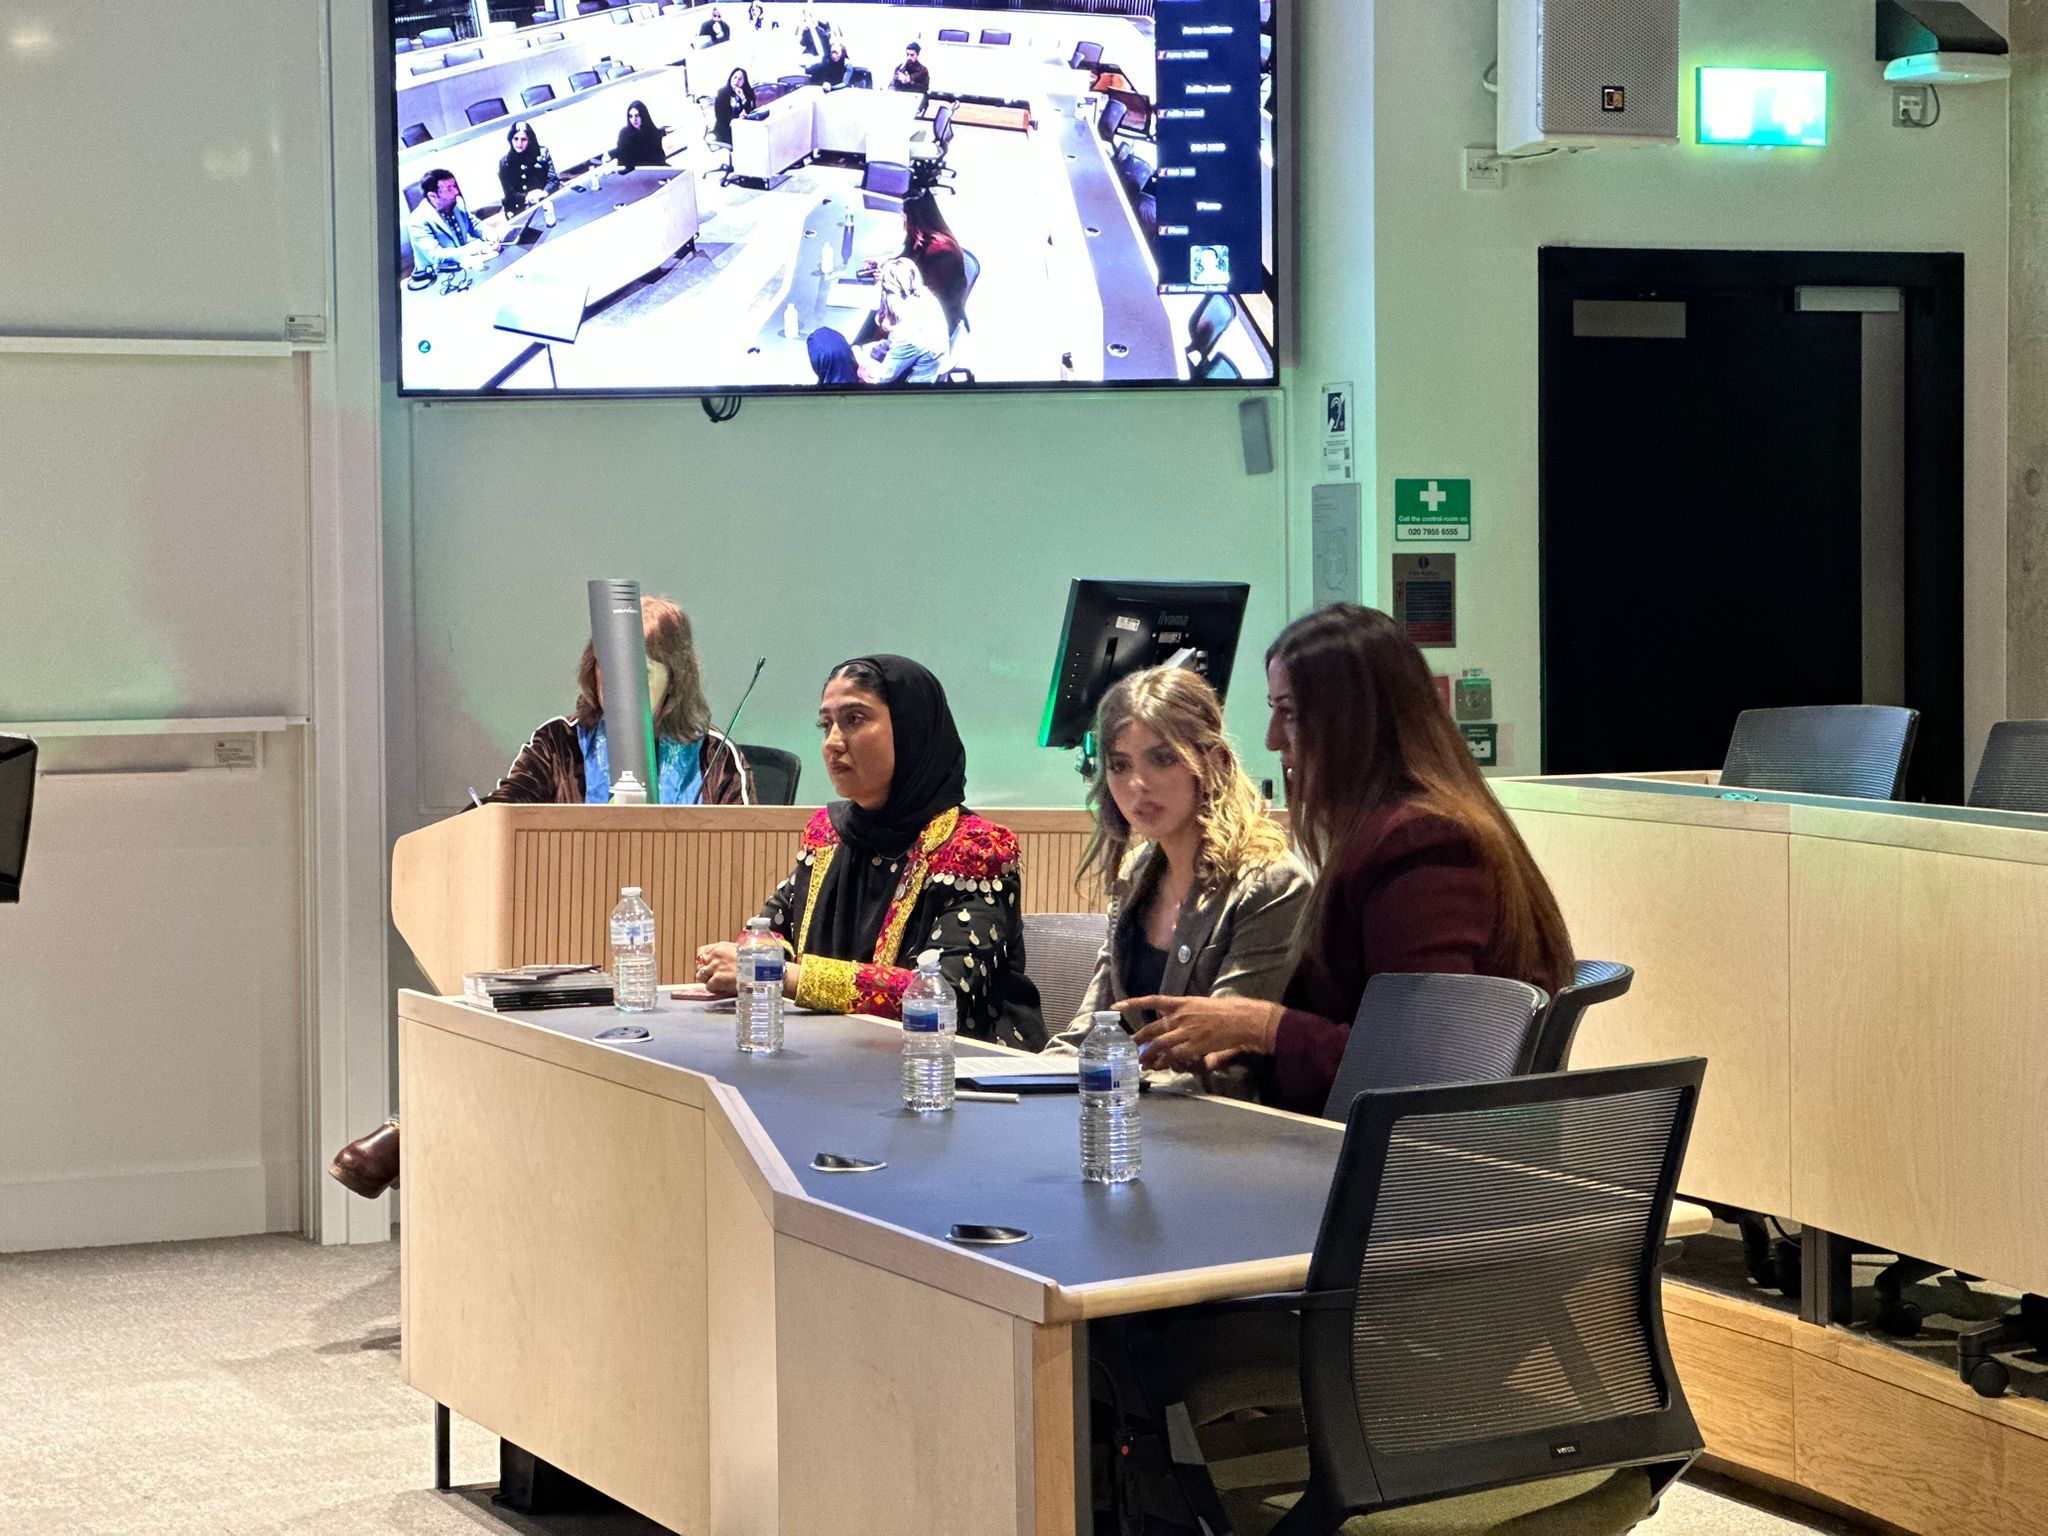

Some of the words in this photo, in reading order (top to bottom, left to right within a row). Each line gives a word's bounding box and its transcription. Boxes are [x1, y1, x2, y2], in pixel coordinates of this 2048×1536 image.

[1408, 528, 1421, 536] 020
[1423, 528, 1440, 536] 7955
[1441, 528, 1458, 536] 6555
